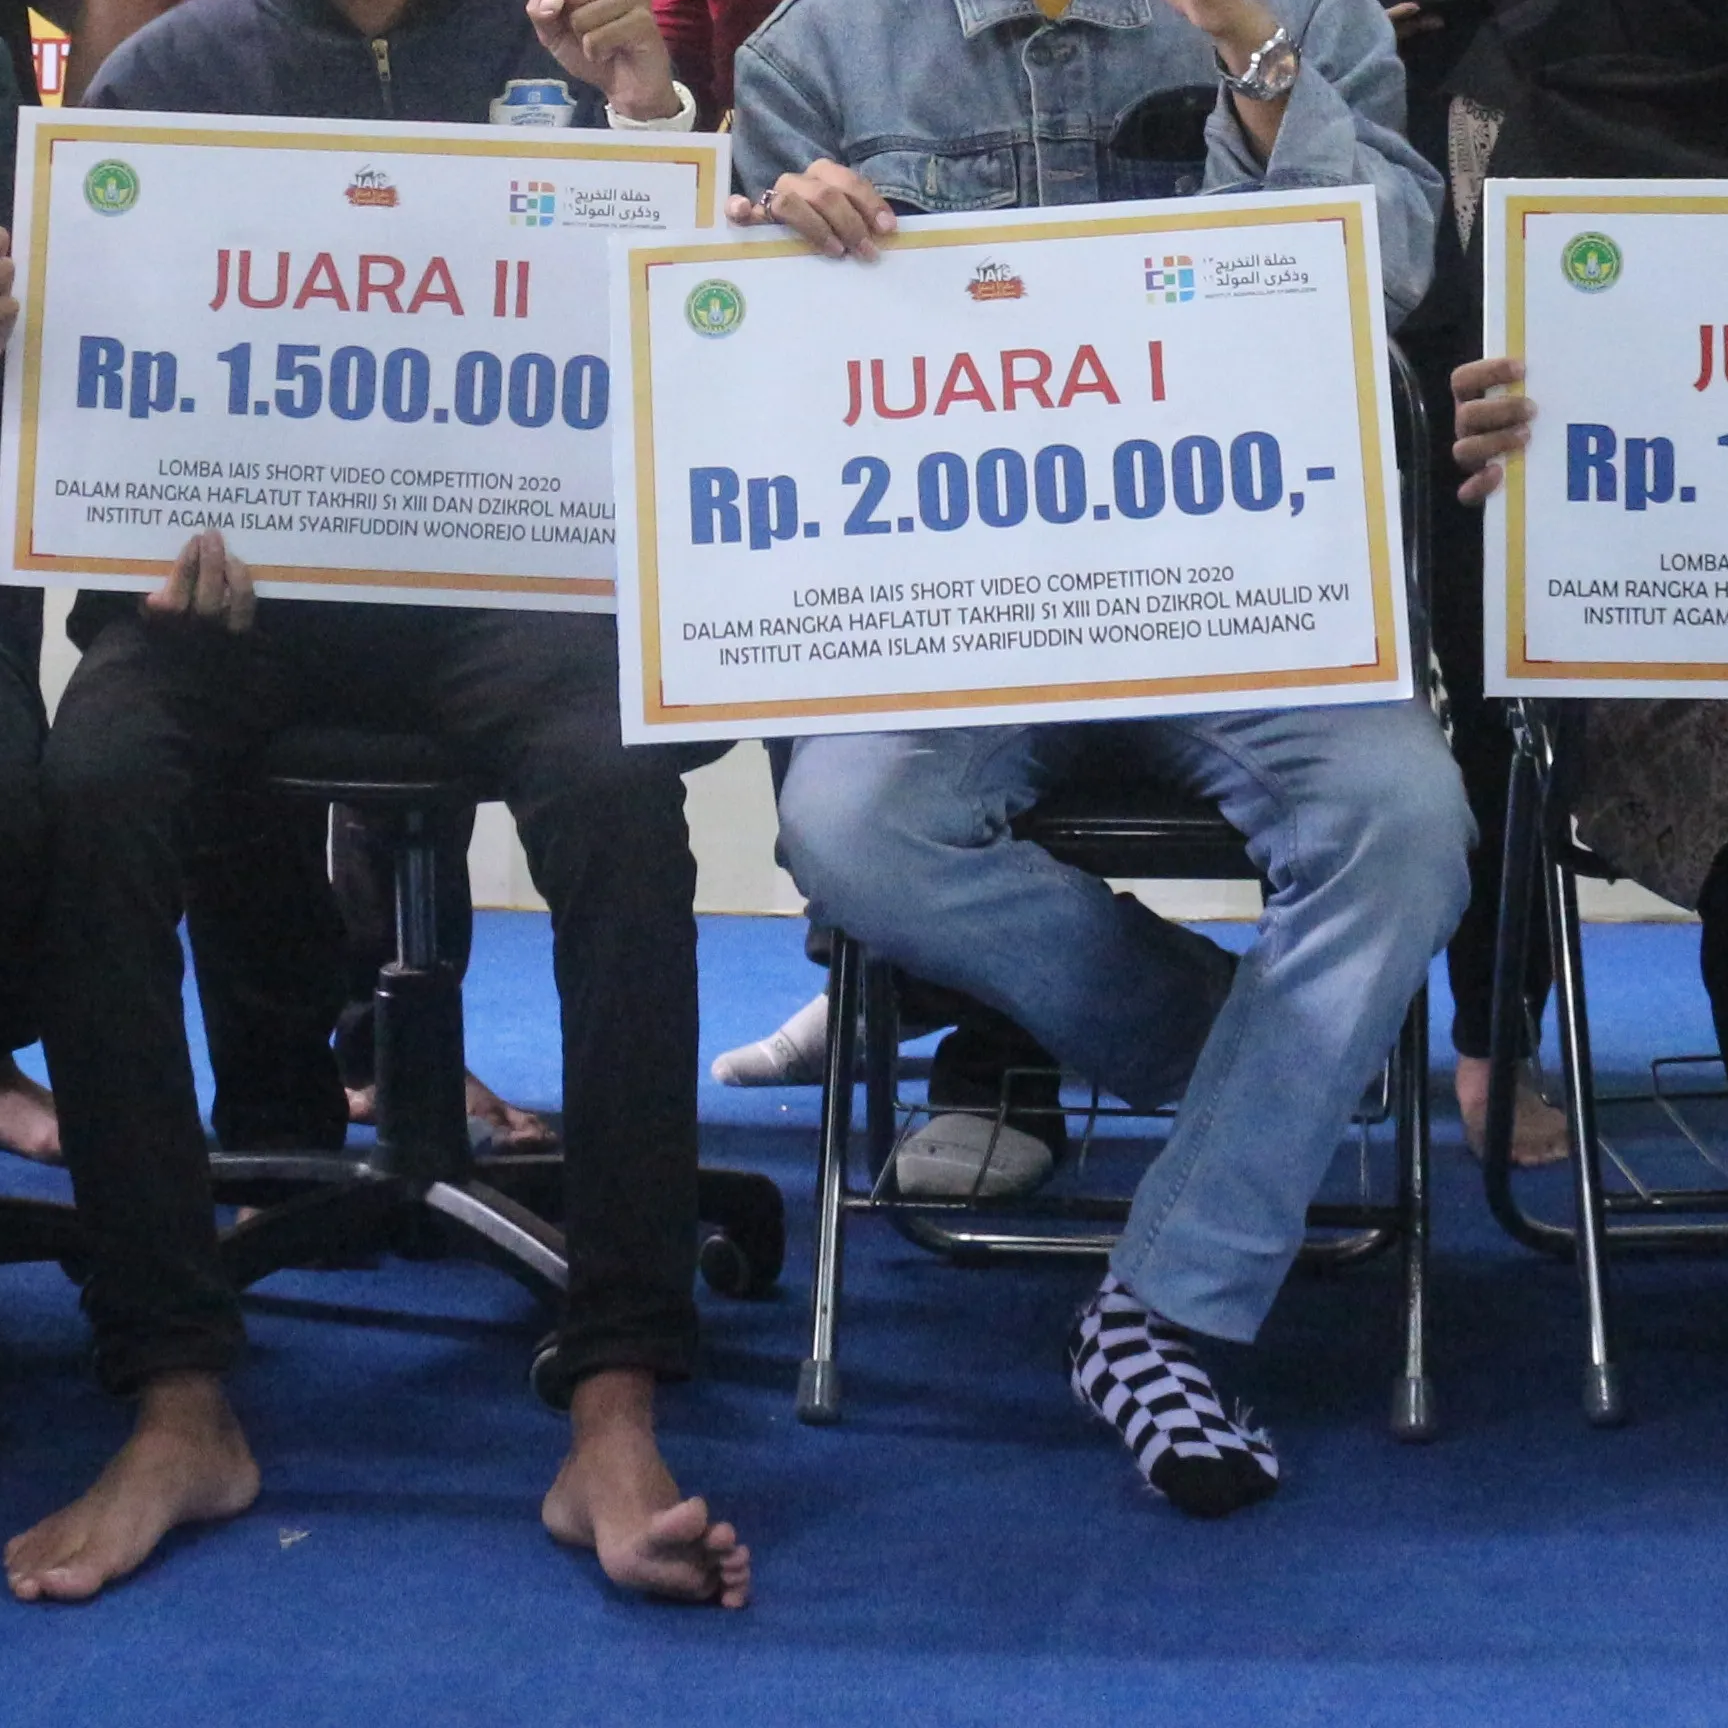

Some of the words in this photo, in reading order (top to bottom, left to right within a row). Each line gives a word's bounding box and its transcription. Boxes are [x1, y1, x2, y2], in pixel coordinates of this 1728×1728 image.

[207, 248, 465, 316] JUARA
[492, 258, 530, 318] II
[75, 334, 196, 420] Rp.
[216, 341, 610, 431] 1.500.000
[842, 343, 1121, 427] JUARA
[1147, 339, 1166, 402] I
[157, 457, 224, 478] LOMBA
[227, 461, 261, 480] IAIS
[264, 462, 326, 483] SHORT
[329, 465, 386, 485] VIDEO
[389, 467, 513, 490] COMPETITION
[517, 475, 561, 493] 2020
[688, 465, 820, 551] Rp.
[840, 429, 1336, 536] 2.000.000,-
[1565, 422, 1696, 511] Rp.
[54, 478, 120, 498] DALAM
[124, 481, 202, 502] RANGKA
[206, 485, 302, 507] HAFLATUT
[306, 489, 377, 511] TAKHRIJ
[400, 493, 427, 513] XIII
[431, 494, 473, 514] DAN
[477, 496, 554, 518] DZIKROL
[558, 499, 616, 520] MAULI
[86, 505, 163, 525] INSTITUT
[166, 508, 235, 529] AGAMA
[240, 511, 293, 531] ISLAM
[298, 514, 419, 537] SYARIFUDDIN
[422, 519, 526, 542] WONOREJO
[530, 524, 616, 545] LUMAJAN
[682, 618, 754, 641] DALAM
[758, 613, 843, 637] RANGKA
[848, 607, 952, 631] HAFLATUT
[956, 601, 1035, 625] TAKHRIJ
[1061, 599, 1090, 618] XIII
[1095, 595, 1141, 617] DAN
[1145, 590, 1231, 614] DZIKROL
[1234, 584, 1313, 608] MAULID
[1316, 582, 1349, 603] XVI
[792, 584, 865, 608] LOMBA
[869, 582, 904, 603] IAIS
[909, 578, 975, 601] SHORT
[979, 574, 1042, 597] VIDEO
[1045, 566, 1182, 593] COMPETITION
[1186, 564, 1234, 584] 2020
[1547, 578, 1619, 598] DALAM
[1624, 579, 1709, 599] RANGKA
[718, 642, 802, 666] INSTITUT
[807, 638, 883, 661] AGAMA
[887, 635, 946, 656] ISLAM
[951, 626, 1083, 653] SYARIFUDDIN
[1087, 618, 1202, 644] WONOREJO
[1206, 611, 1316, 637] LUMAJANG
[1583, 605, 1667, 626] INSTITUT
